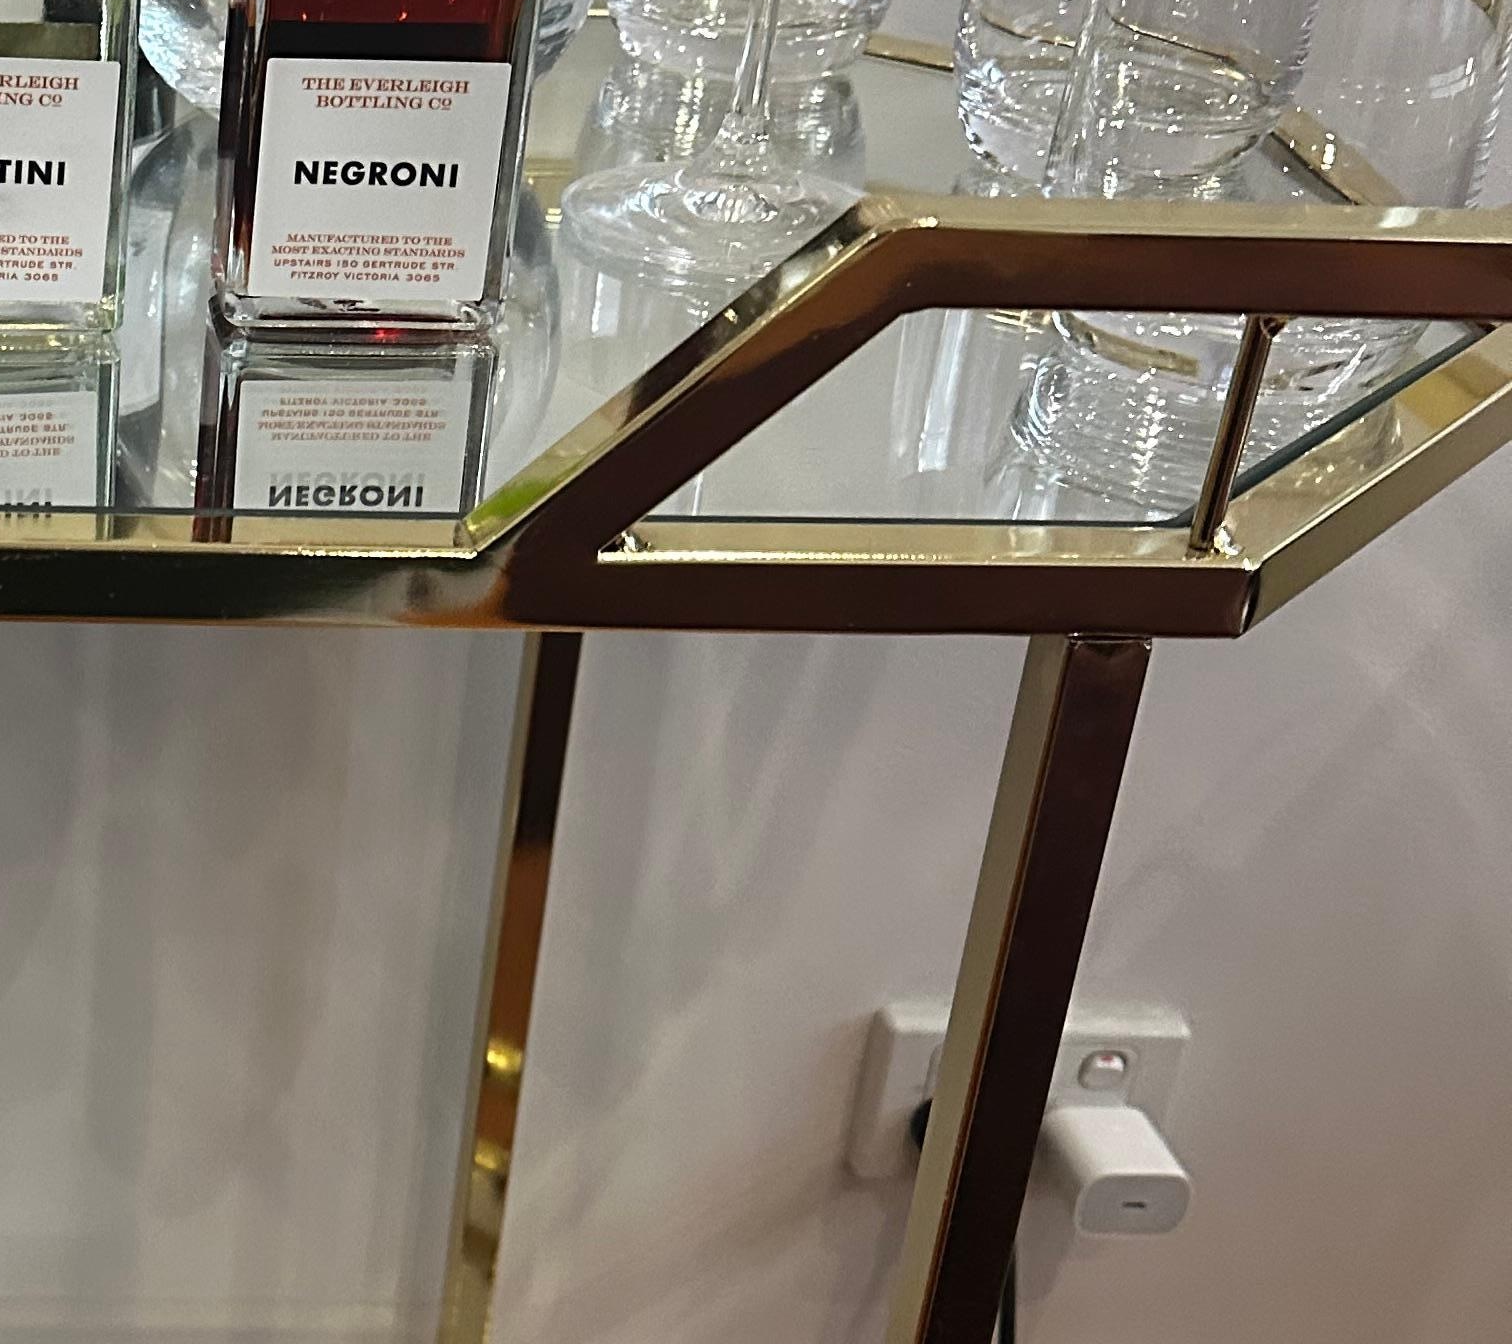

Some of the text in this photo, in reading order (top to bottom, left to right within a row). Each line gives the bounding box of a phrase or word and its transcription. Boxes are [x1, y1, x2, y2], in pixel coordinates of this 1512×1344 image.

[302, 77, 470, 94] THE EVERLEIGH
[316, 95, 422, 110] BOTTLING
[294, 160, 459, 188] NEGRONI
[19, 234, 37, 244] TO
[40, 235, 70, 245] THE
[287, 233, 452, 246] MANUFACTURED TO THE
[1, 246, 83, 257] STANDARDS
[271, 245, 465, 258] MOST EXACTING STANDARDS
[274, 258, 332, 268] UPSTAIRS
[337, 259, 358, 268] 150
[363, 260, 426, 270] GERTRUDE
[24, 272, 59, 281] 3065
[290, 271, 440, 282] FITZROY VICTORIA 3065
